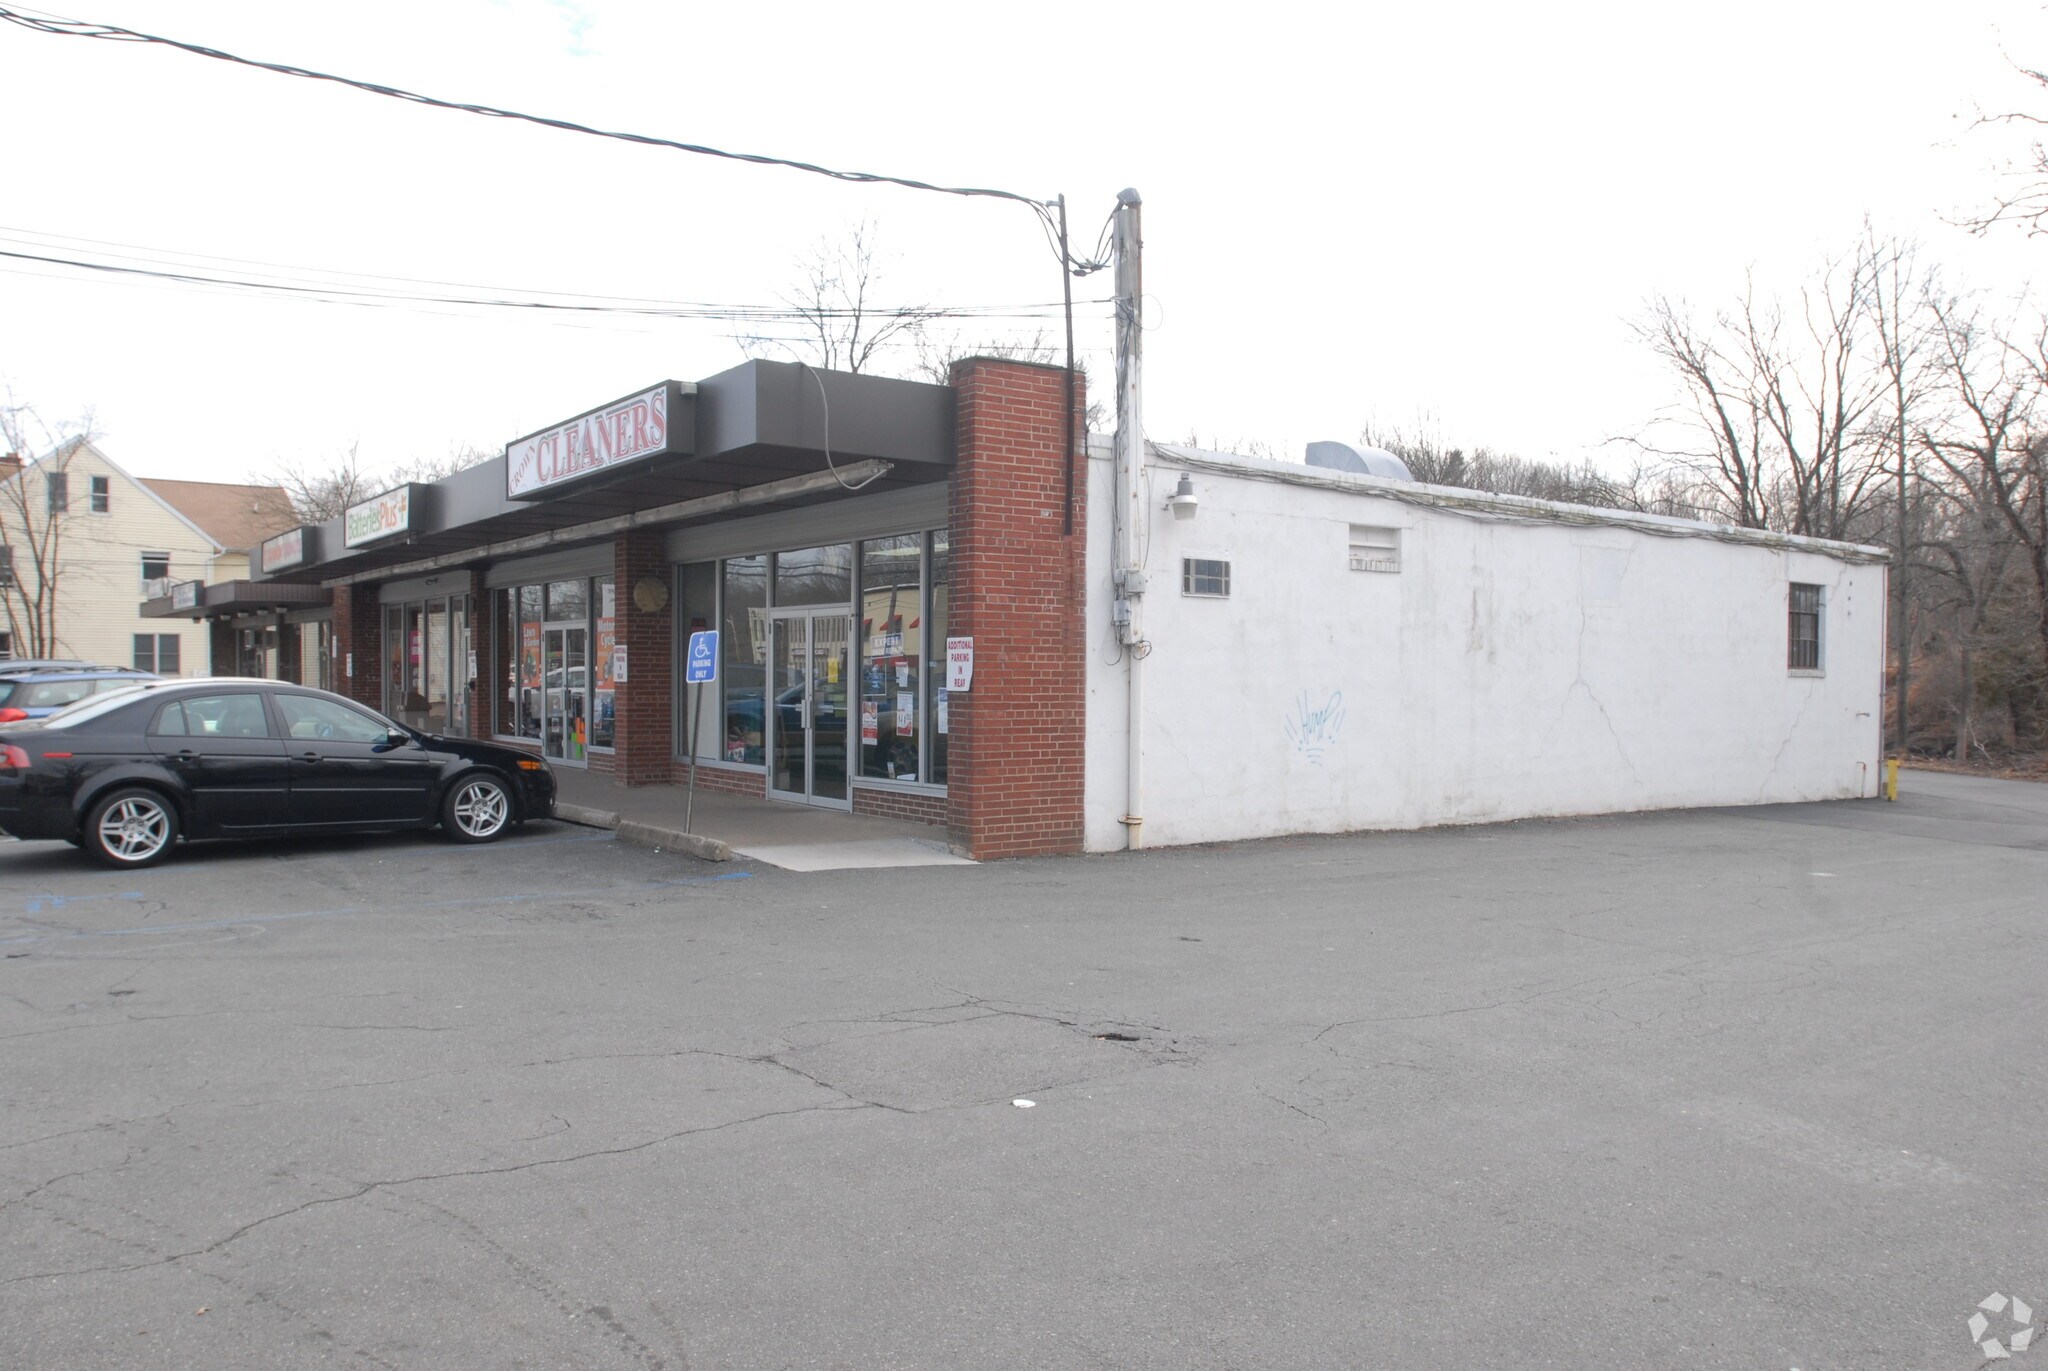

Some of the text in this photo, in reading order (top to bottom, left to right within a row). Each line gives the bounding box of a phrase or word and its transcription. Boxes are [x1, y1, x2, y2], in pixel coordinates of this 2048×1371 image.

[537, 392, 665, 485] CLEANERS
[509, 442, 535, 494] CROWN
[874, 636, 900, 647] EXPERT
[948, 640, 972, 650] ADDITIONAL
[951, 653, 970, 662] PARKING
[692, 658, 711, 668] PARKING
[695, 670, 707, 679] ONLY
[958, 665, 963, 674] IN
[954, 678, 966, 687] REAR
